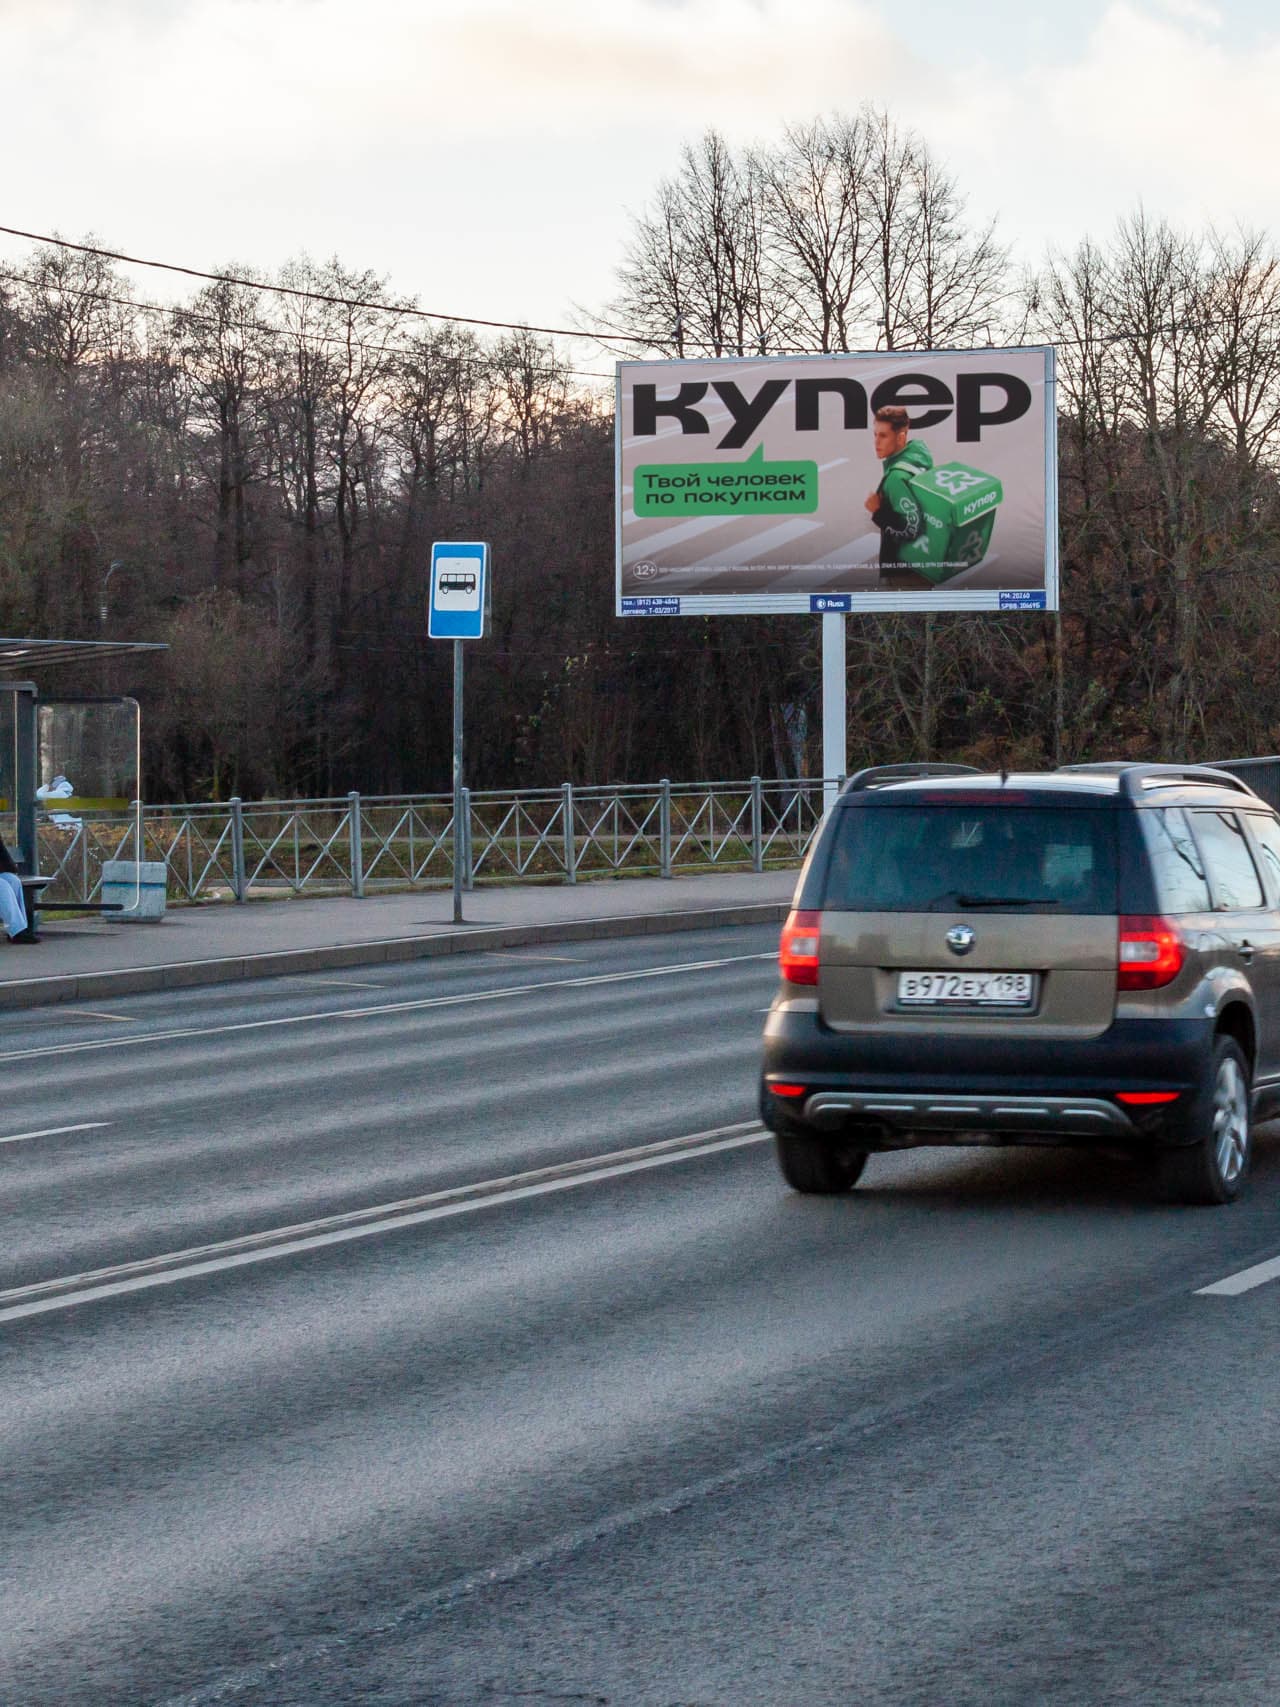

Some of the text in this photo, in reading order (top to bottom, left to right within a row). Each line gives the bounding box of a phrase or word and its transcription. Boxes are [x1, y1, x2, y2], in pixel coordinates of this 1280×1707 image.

[633, 373, 1031, 449] купер
[643, 473, 806, 488] Твой человек
[646, 490, 806, 505] по покупкам
[963, 491, 997, 515] купер
[636, 564, 656, 576] 12+
